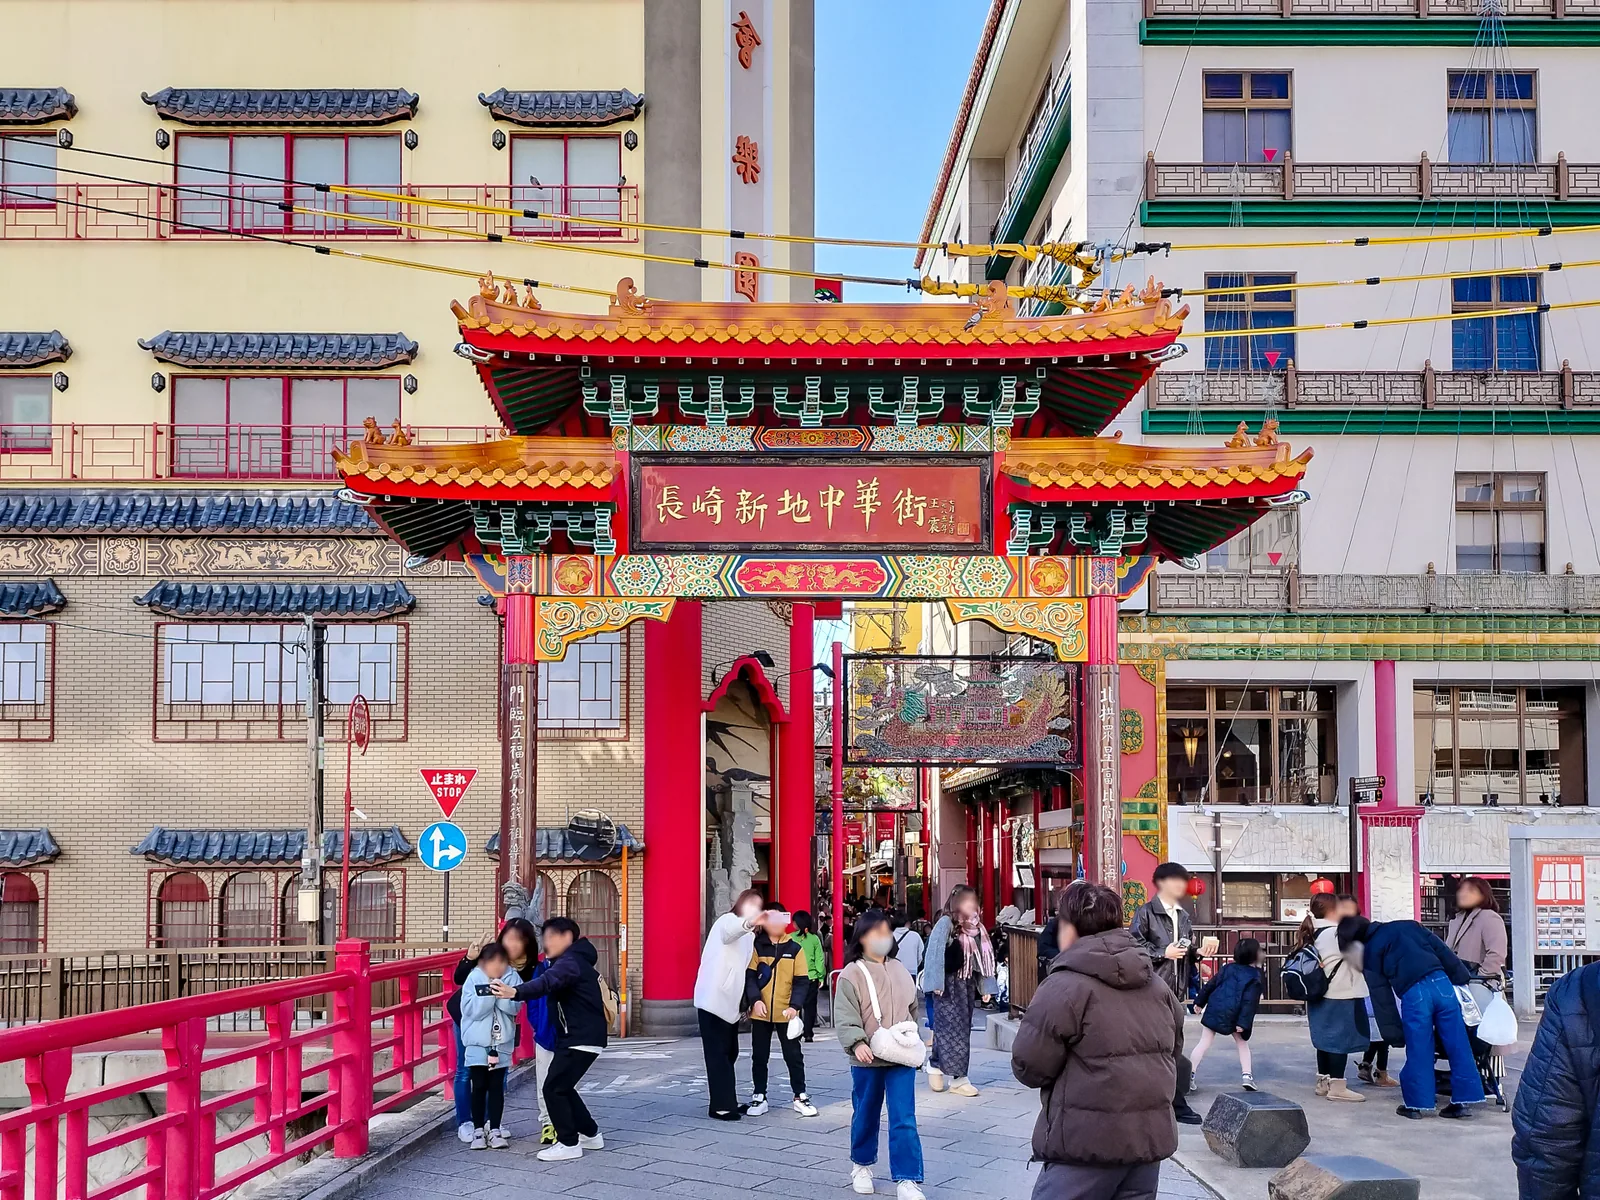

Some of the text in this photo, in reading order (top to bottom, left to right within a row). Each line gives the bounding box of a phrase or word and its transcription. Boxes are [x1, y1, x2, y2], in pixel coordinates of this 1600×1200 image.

[656, 477, 928, 532] 長崎新地中華街
[430, 772, 467, 786] 止まれ
[436, 787, 462, 798] STOP
